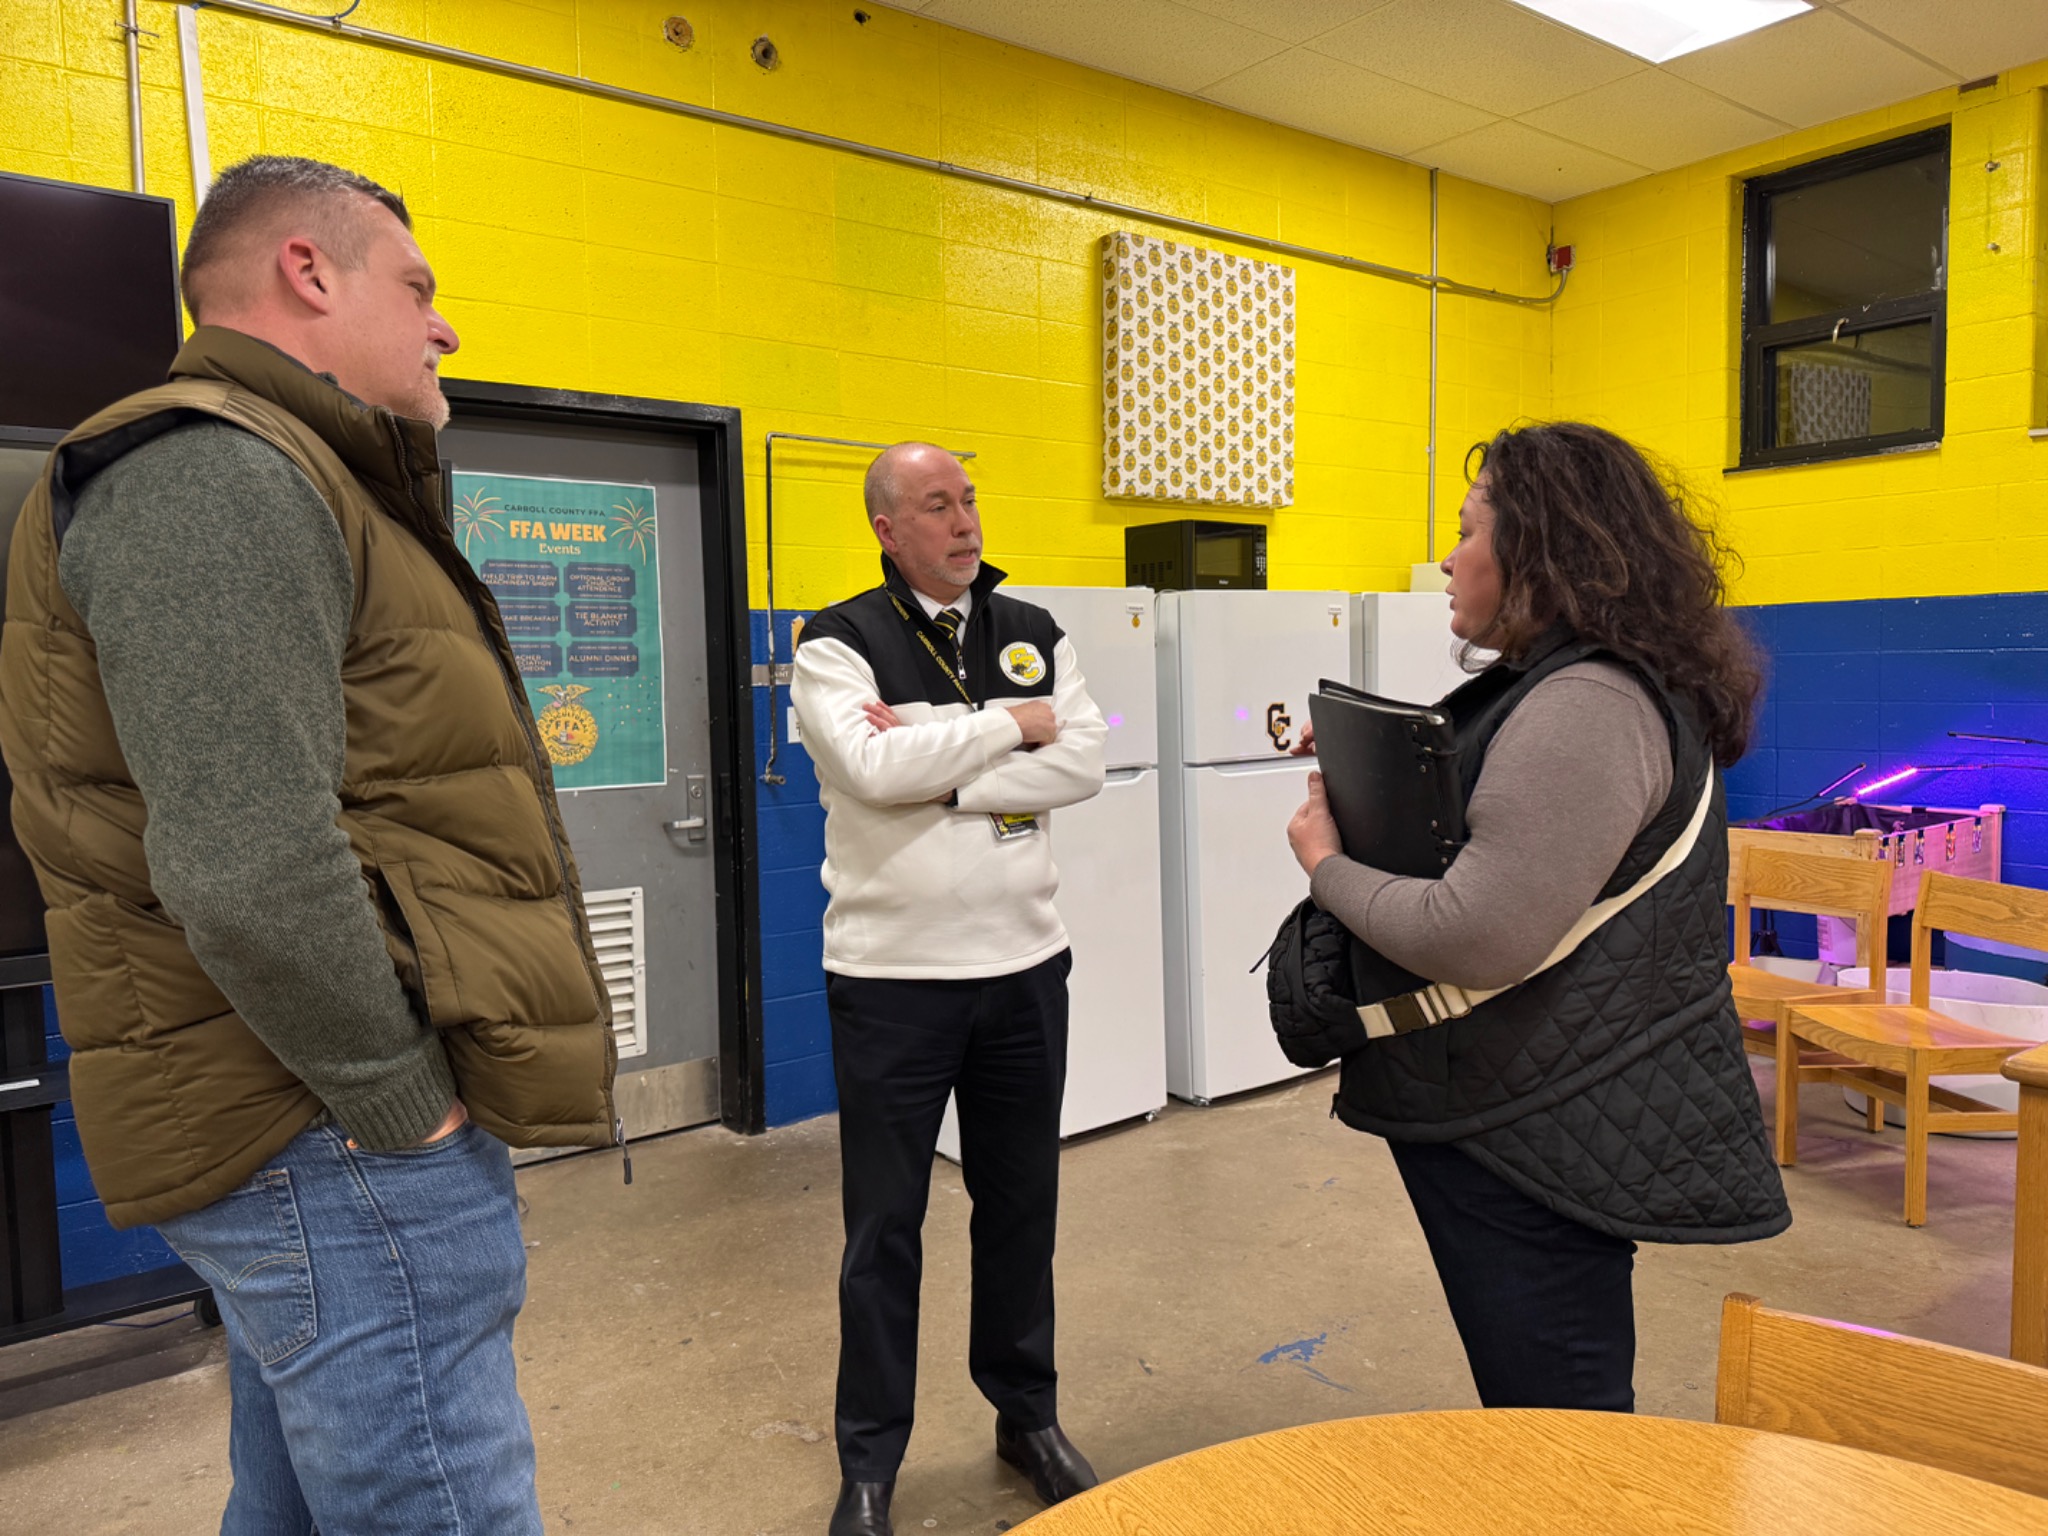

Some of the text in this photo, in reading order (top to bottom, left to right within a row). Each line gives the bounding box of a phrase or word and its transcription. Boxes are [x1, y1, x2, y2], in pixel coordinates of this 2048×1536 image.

[504, 504, 606, 517] CARROLL COUNTY FFA
[509, 519, 607, 543] FFA WEEK
[538, 543, 582, 555] Events
[537, 574, 558, 582] FARM
[520, 614, 560, 622] BREAKFAST
[575, 611, 628, 621] TIE BLANKET
[584, 619, 620, 627] ACTIVITY
[568, 654, 638, 662] ALUMNI DINNER
[916, 630, 938, 657] CARROLL
[936, 655, 955, 679] COUNTY
[555, 720, 580, 731] FFA
